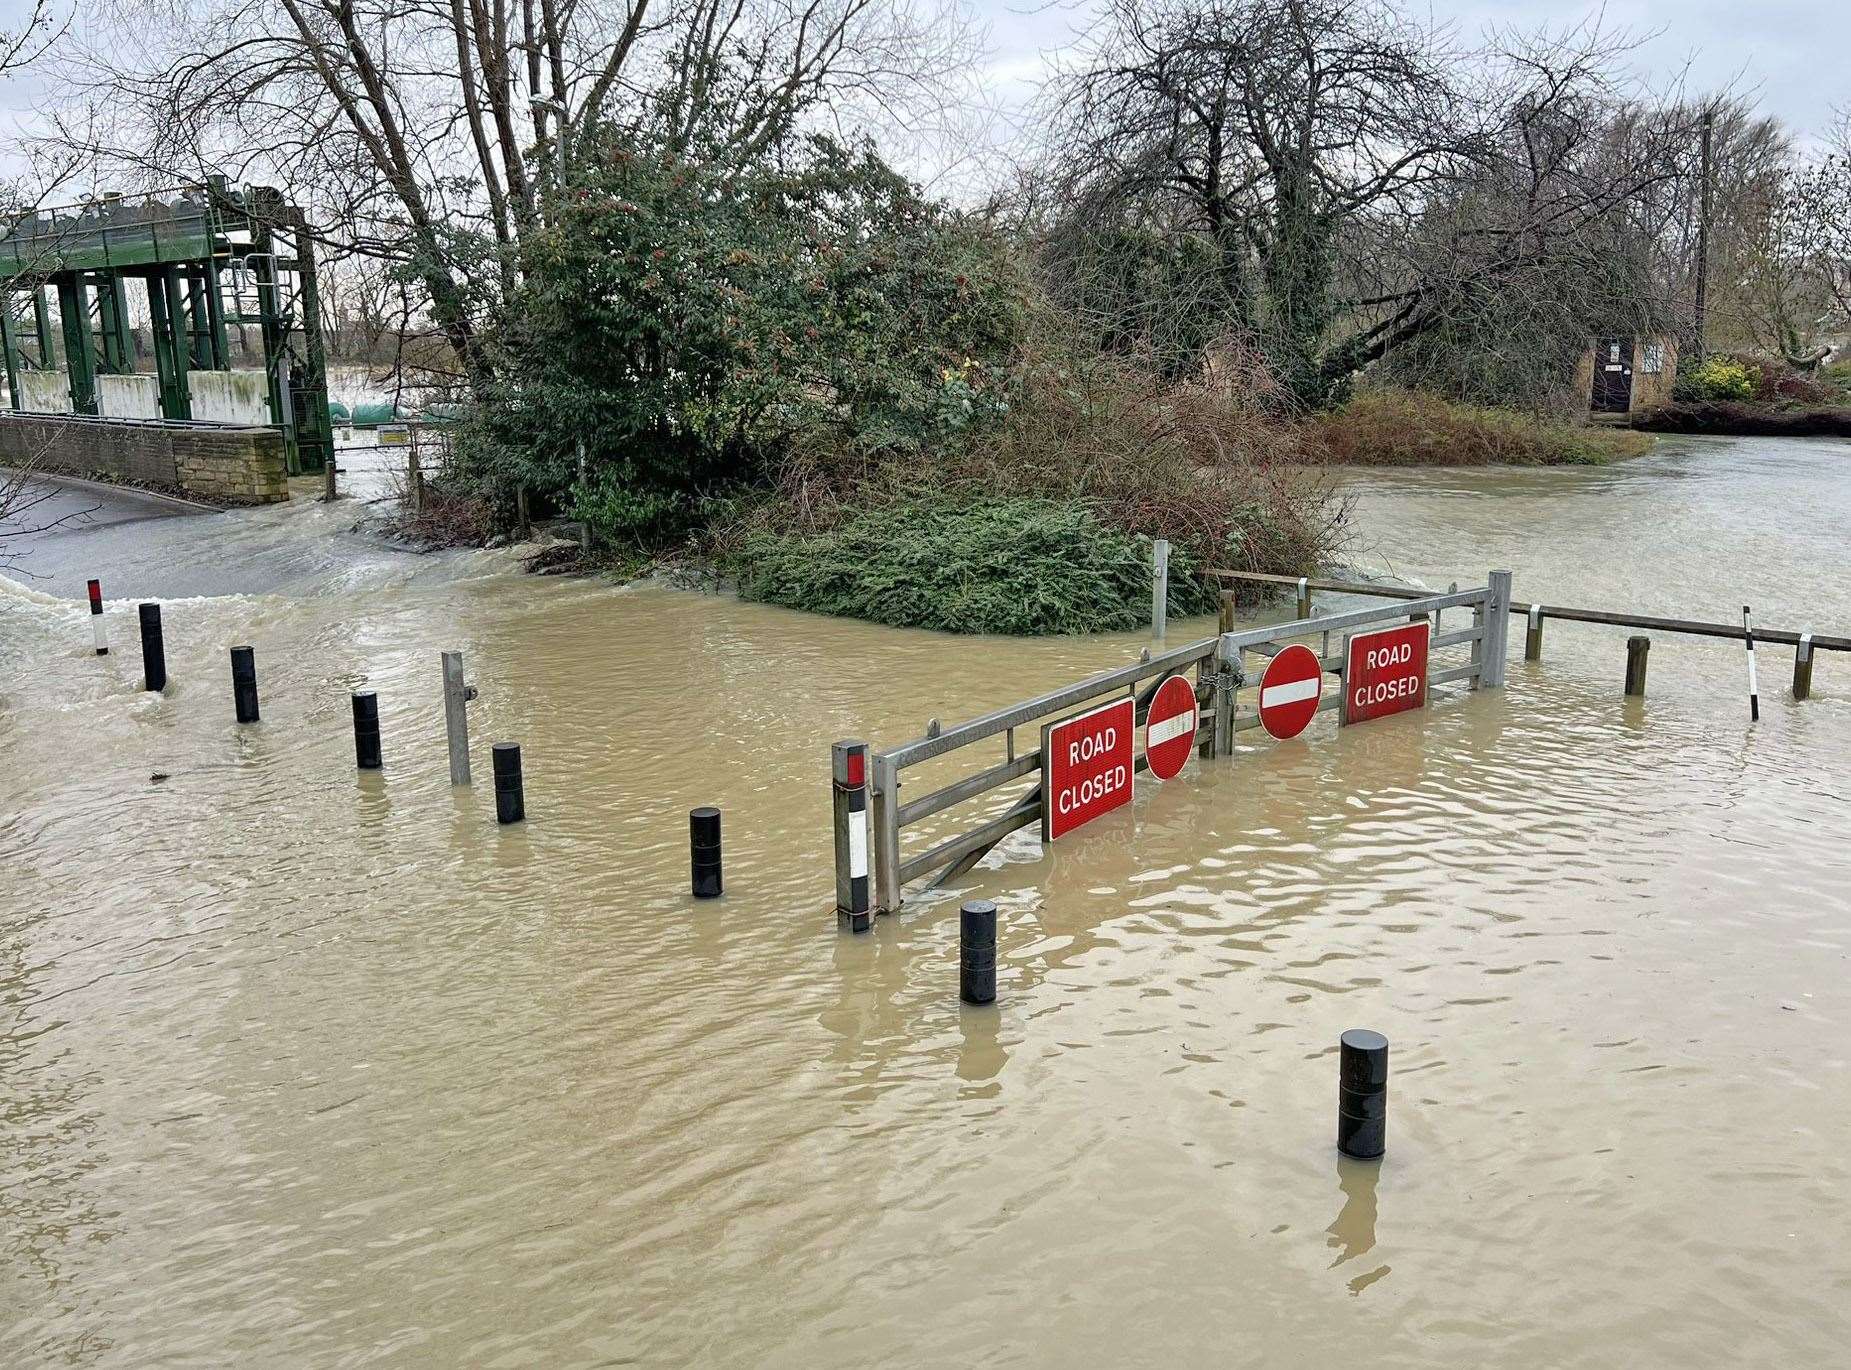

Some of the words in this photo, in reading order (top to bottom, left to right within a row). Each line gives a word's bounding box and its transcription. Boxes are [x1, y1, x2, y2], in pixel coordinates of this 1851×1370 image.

[1368, 643, 1412, 670] ROAD
[1355, 675, 1419, 707] CLOSED
[1069, 727, 1117, 767] ROAD
[1059, 765, 1126, 815] CLOSED
